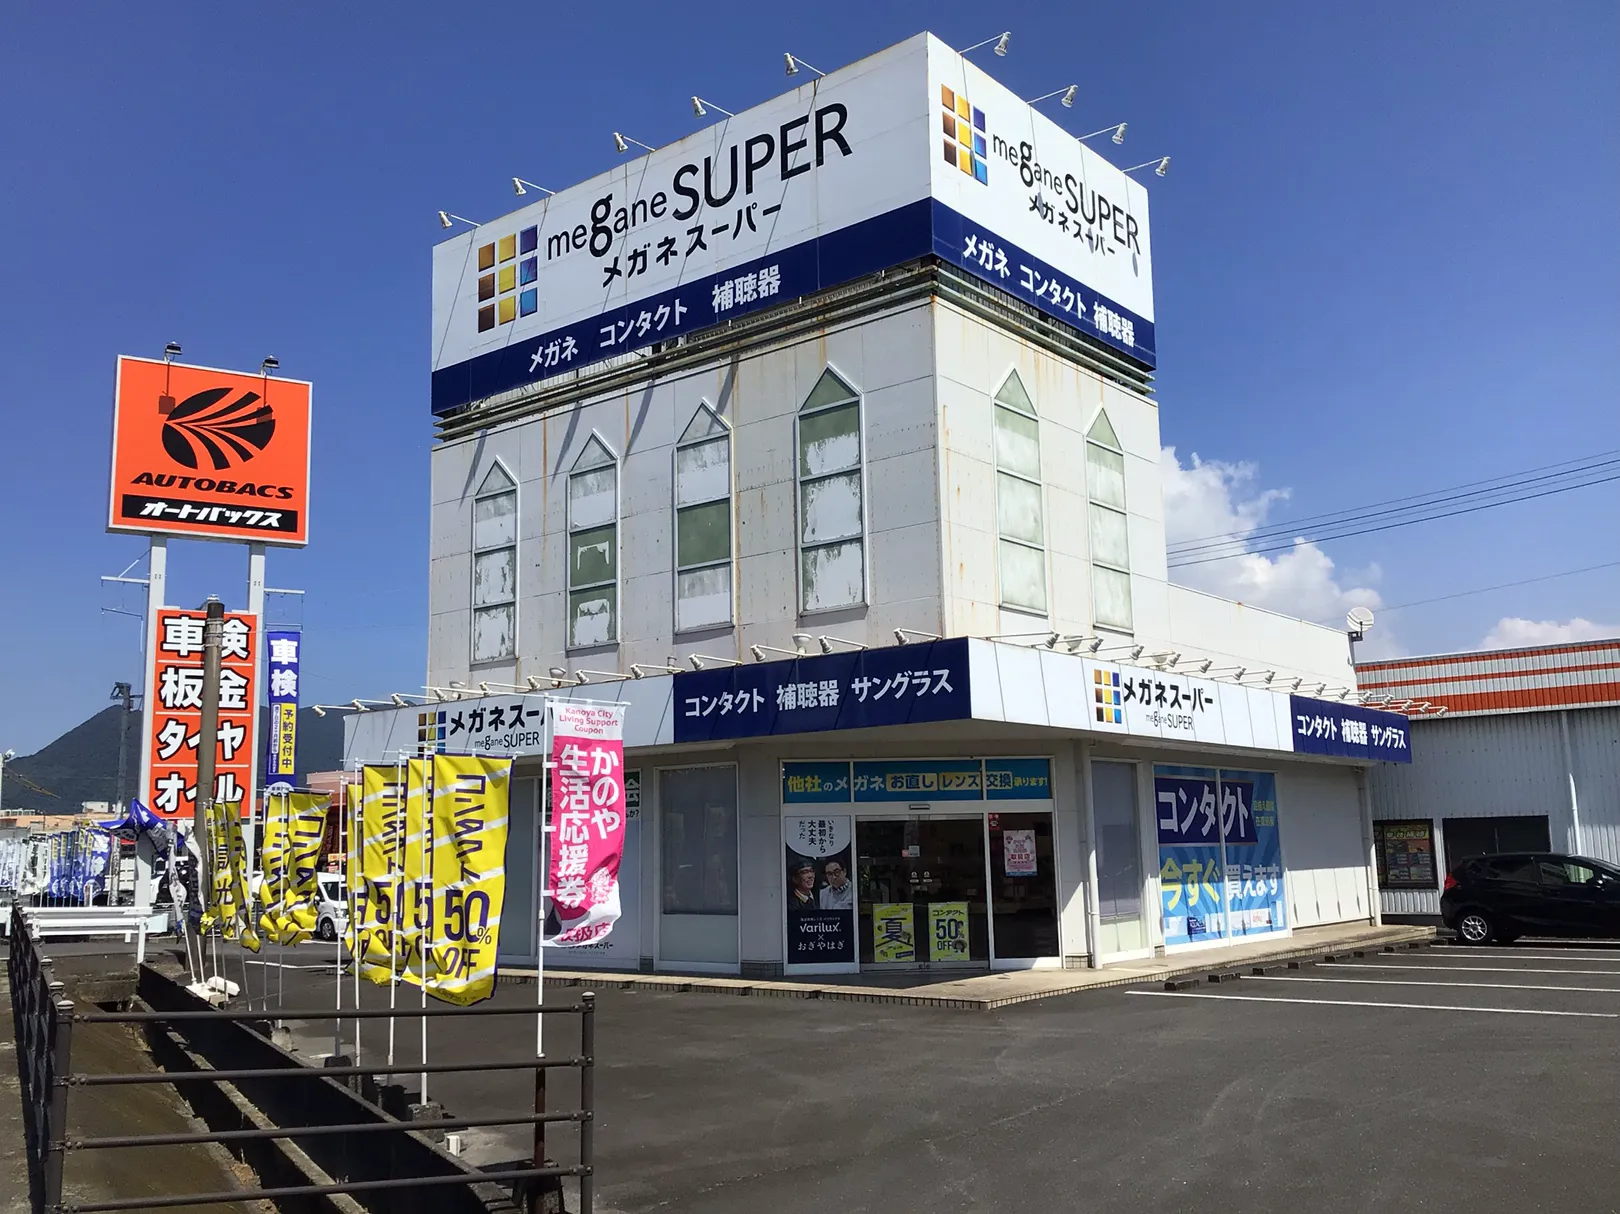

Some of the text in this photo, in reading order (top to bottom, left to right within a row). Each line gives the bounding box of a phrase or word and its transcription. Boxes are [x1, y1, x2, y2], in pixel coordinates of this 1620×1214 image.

[602, 201, 782, 288] メガネスーパー
[1029, 194, 1116, 256] メガネスーパー
[962, 233, 1136, 348] メガネ コンタクト 補聴器
[528, 264, 782, 373] メガネ コンタクト 補聴器
[130, 472, 294, 499] AUTOBACS
[139, 501, 283, 528] オートバックス
[160, 667, 249, 709] 板金
[270, 638, 298, 698] 車検
[565, 707, 613, 719] Kanoya City
[684, 669, 953, 717] コンタクト 補聴器 サングラス
[1123, 677, 1214, 713] メガネスーパー
[282, 709, 294, 768] 予約受付中
[559, 715, 618, 727] Living Support
[574, 725, 604, 734] Coupon
[1296, 714, 1407, 749] コンタクト 補聴器 サングラス
[591, 746, 621, 840] かのや
[1158, 784, 1249, 838] コンタクト
[454, 774, 486, 881] コンタクト
[557, 744, 590, 910] 生活応援券
[798, 820, 806, 840] だった
[808, 820, 817, 846] 大丈夫
[818, 820, 827, 854] 最初から
[444, 889, 492, 945] 50%
[932, 909, 965, 917] コンタクト
[797, 940, 845, 951] おぎやはぎ
